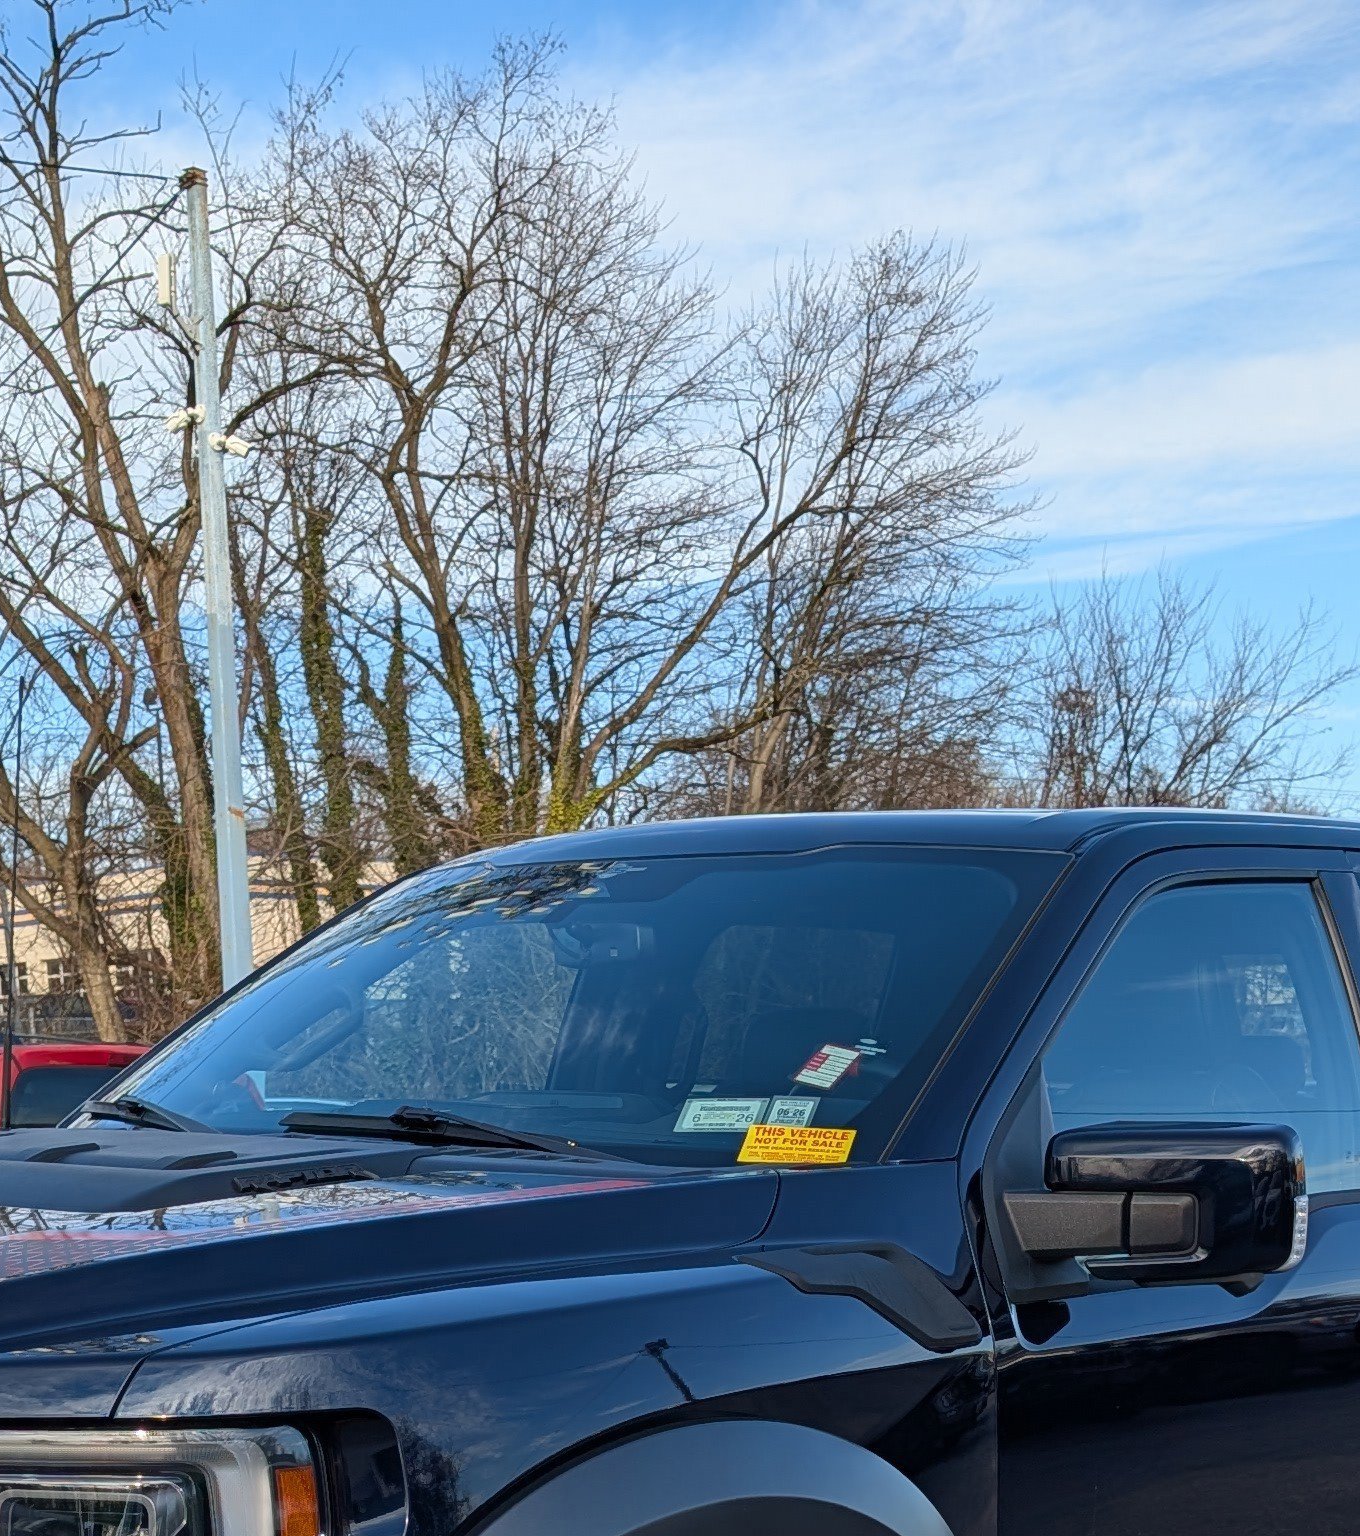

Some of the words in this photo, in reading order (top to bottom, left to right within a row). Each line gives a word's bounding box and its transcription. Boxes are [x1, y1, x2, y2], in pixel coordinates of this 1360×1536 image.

[736, 1113, 754, 1123] 26
[754, 1126, 785, 1137] THIS
[790, 1129, 850, 1141] VEHICLE
[754, 1137, 778, 1145] NOT
[782, 1138, 807, 1147] FOR
[811, 1140, 844, 1149] SALE
